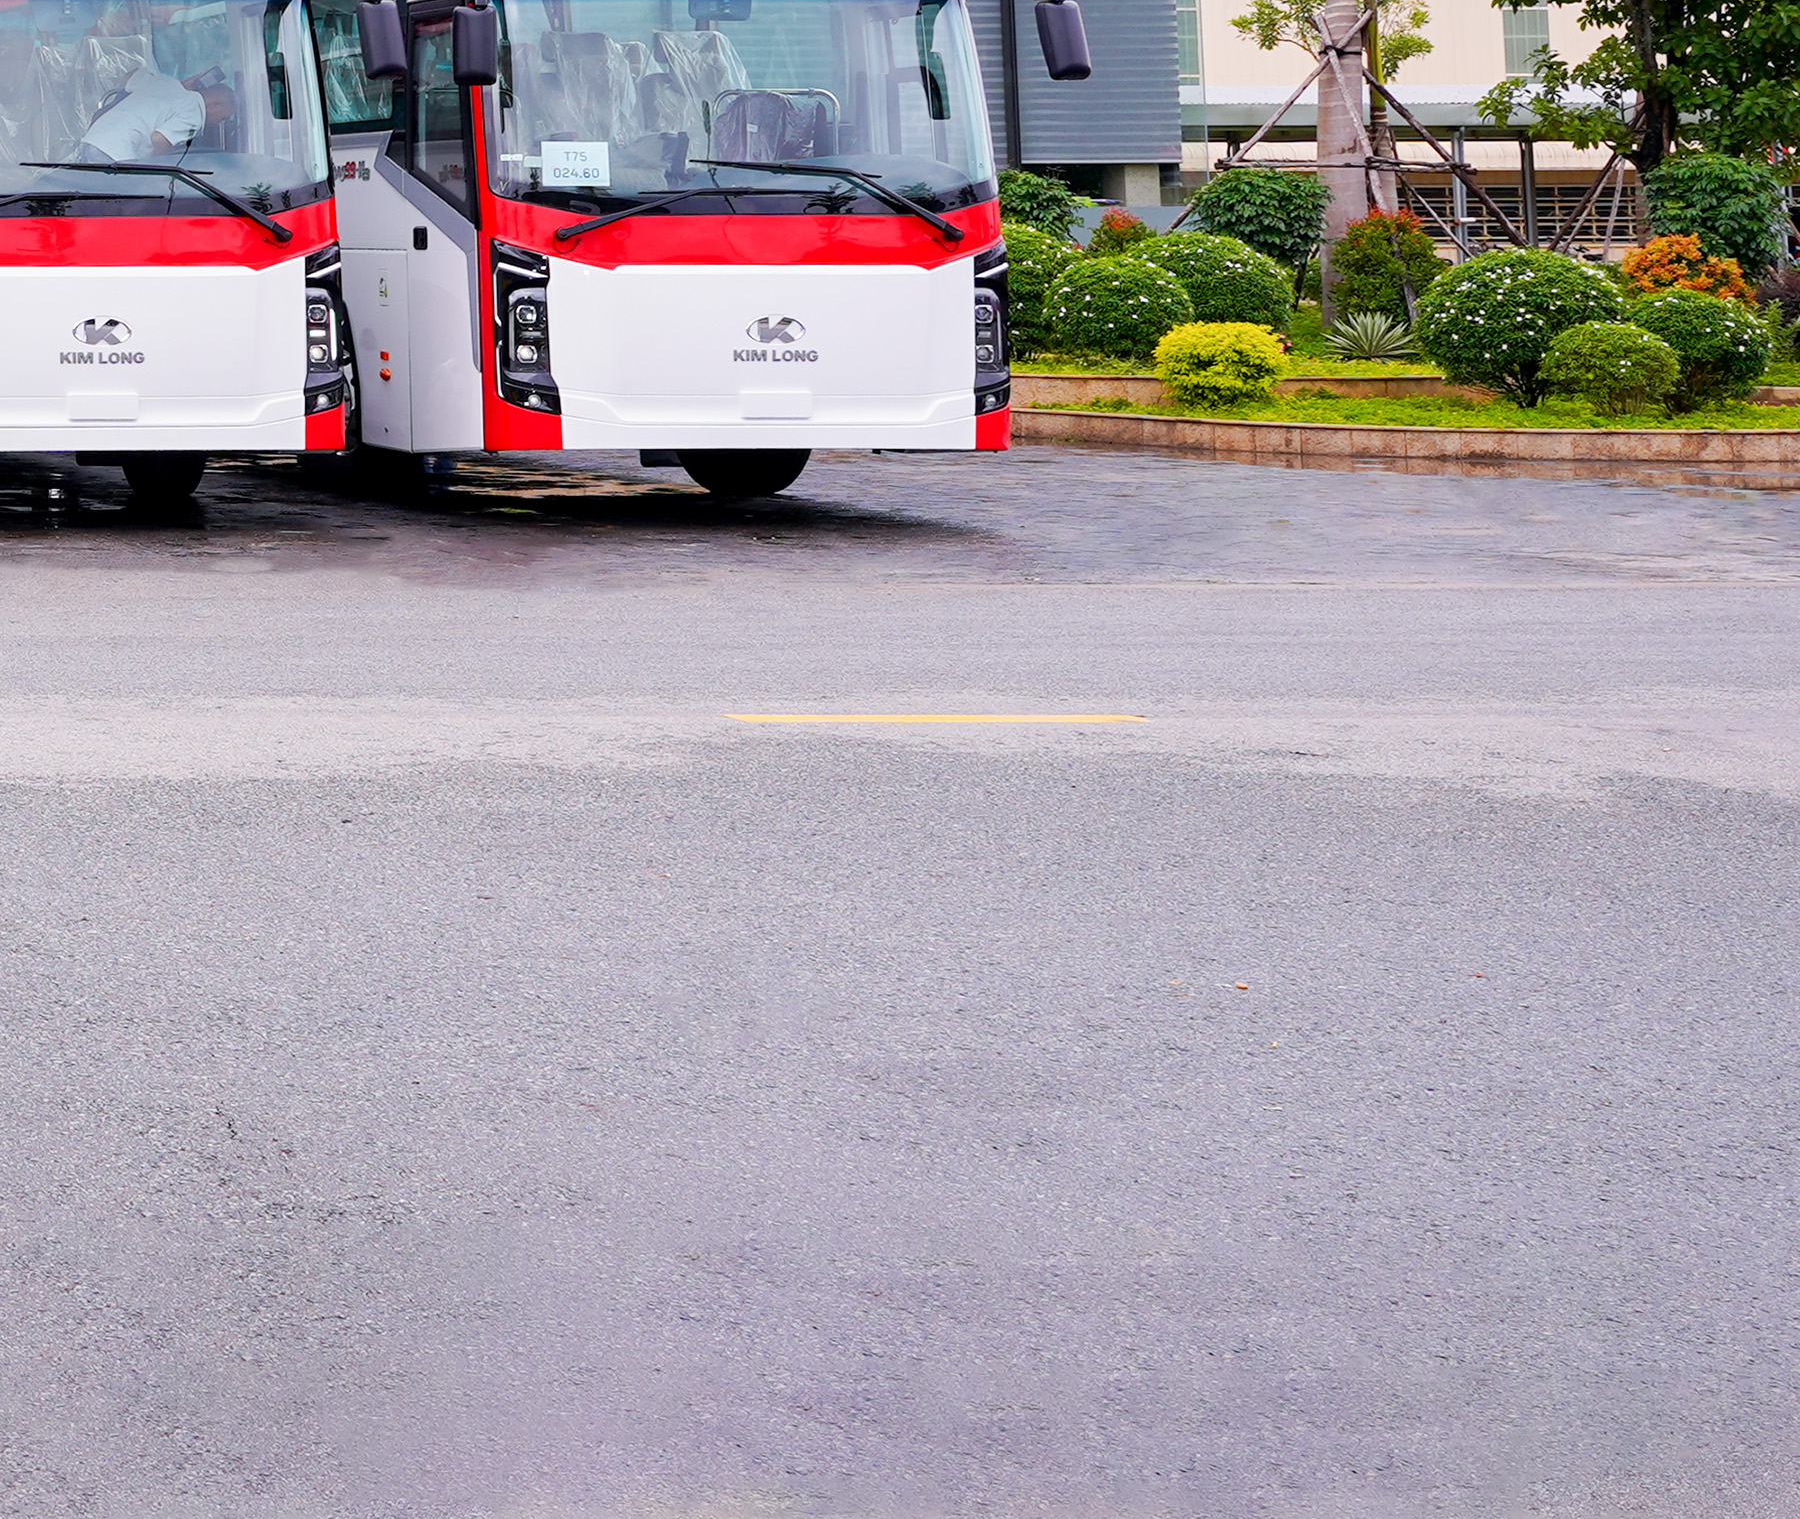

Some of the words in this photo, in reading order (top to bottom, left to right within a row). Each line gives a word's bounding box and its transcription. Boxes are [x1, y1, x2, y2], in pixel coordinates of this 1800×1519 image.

[553, 167, 600, 179] 024.60
[60, 352, 94, 364] KIM
[98, 352, 145, 364] LONG
[733, 349, 767, 362] KIM
[772, 349, 819, 362] LONG
